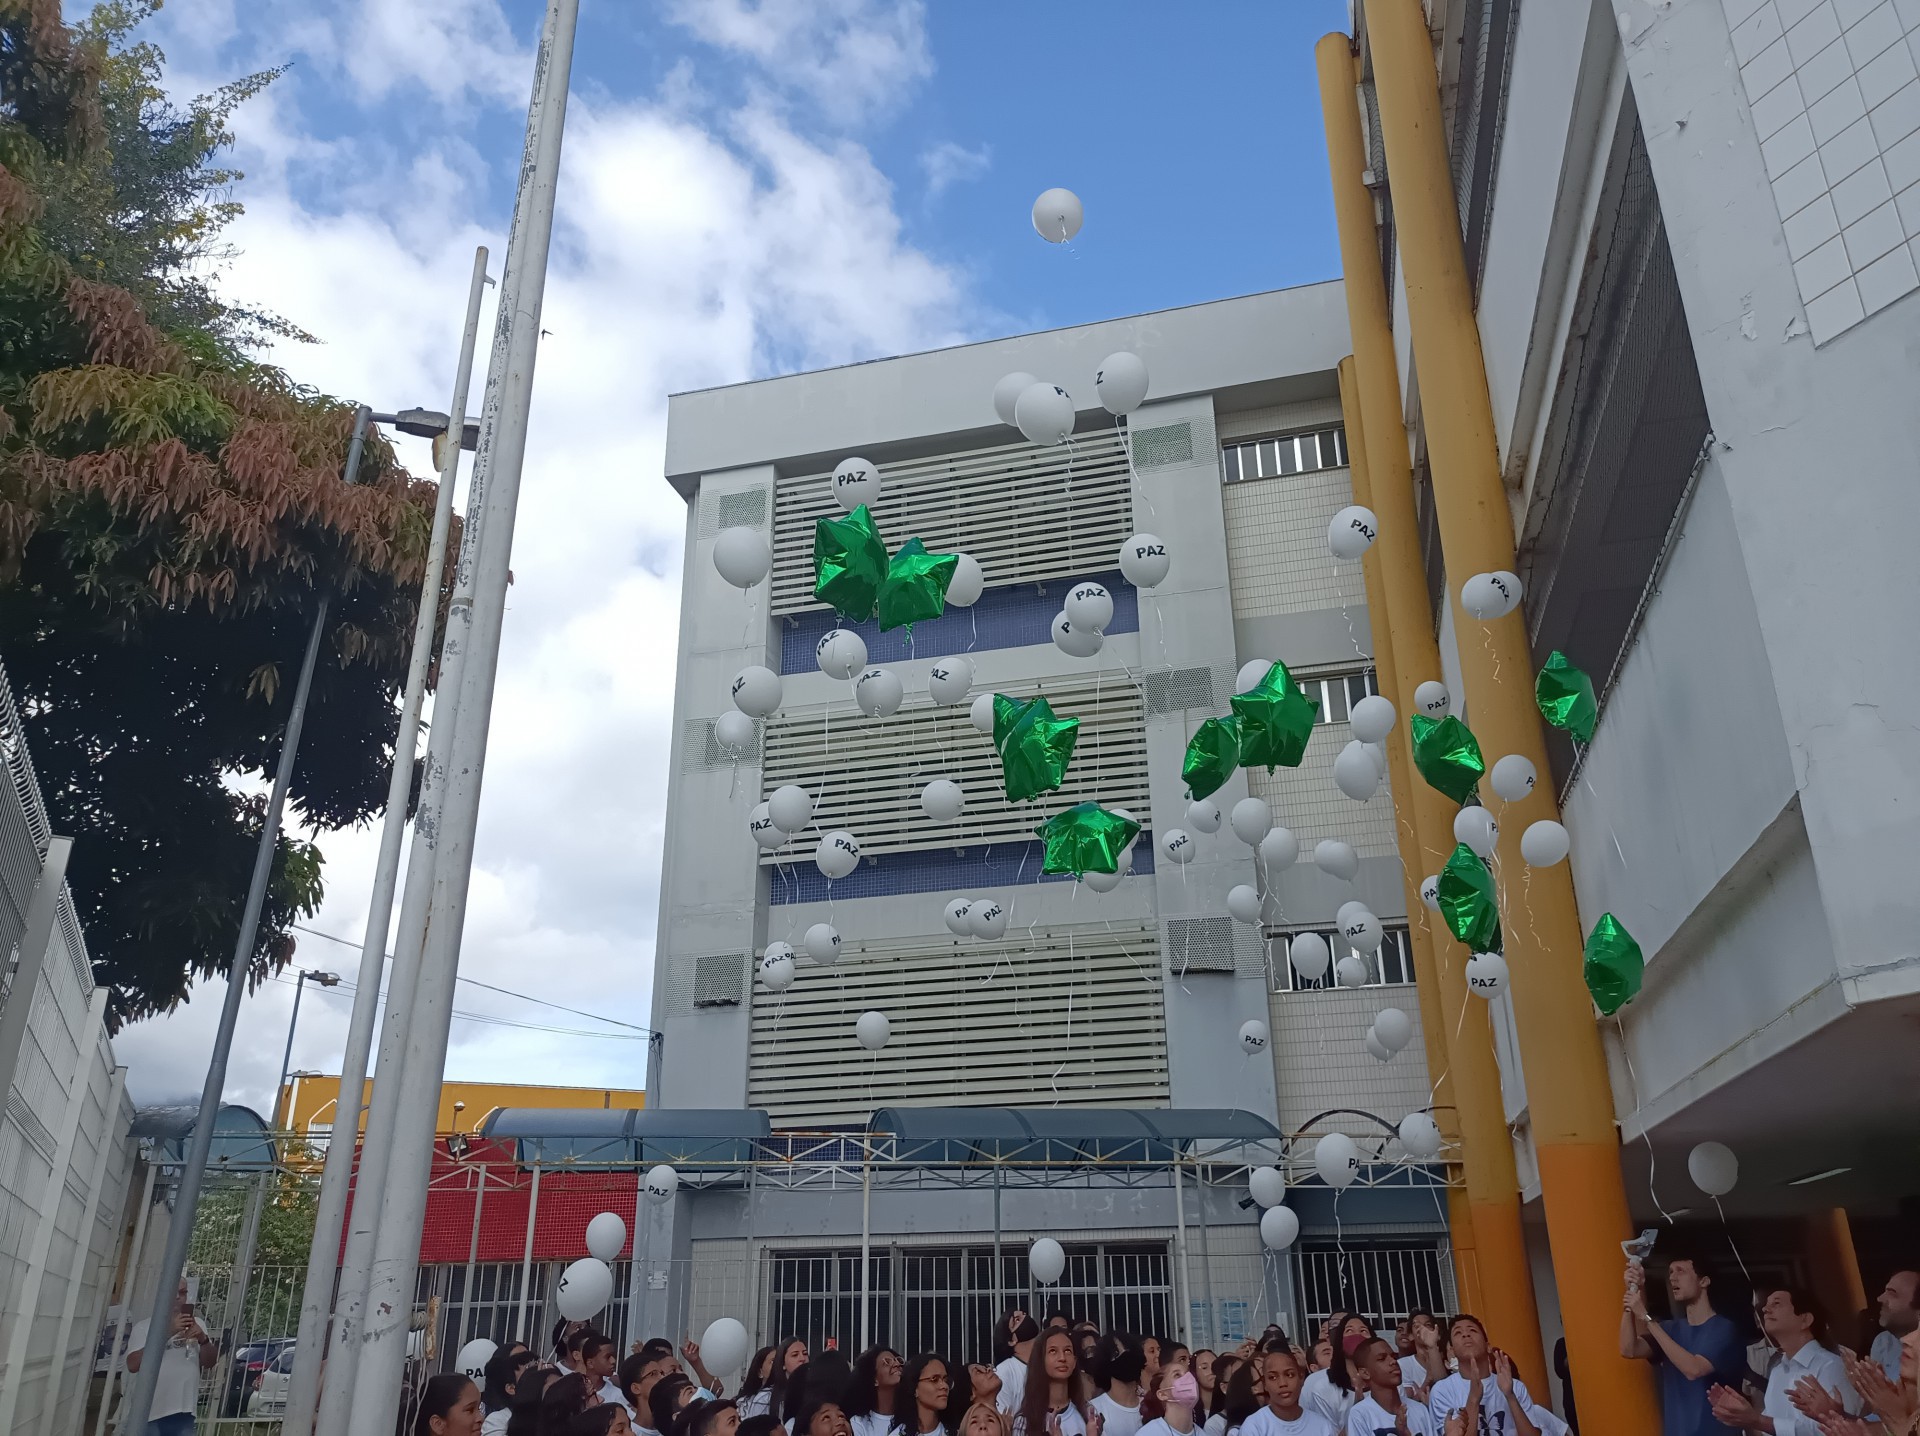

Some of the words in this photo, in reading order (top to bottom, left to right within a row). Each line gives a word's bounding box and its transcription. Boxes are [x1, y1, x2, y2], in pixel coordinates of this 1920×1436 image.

[837, 471, 867, 486] PAZ
[1350, 519, 1375, 542] PAZ
[1136, 545, 1166, 559] PAZ
[1076, 588, 1105, 601] PAZ
[732, 676, 745, 698] AZ
[1427, 697, 1447, 710] PAZ
[750, 818, 772, 832] PAZ
[835, 839, 858, 857] PAZ
[1169, 835, 1188, 851] PAZ
[1423, 887, 1436, 899] PA
[955, 904, 971, 918] PA
[984, 905, 1002, 921] PAZ
[1345, 923, 1366, 938] PAZ
[832, 934, 842, 945] PA
[765, 955, 785, 968] PAZ
[1471, 977, 1497, 988] PAZ
[1245, 1035, 1264, 1046] PAZ
[1348, 1158, 1359, 1169] PA
[649, 1185, 668, 1196] PAZ
[466, 1368, 486, 1378] PA
